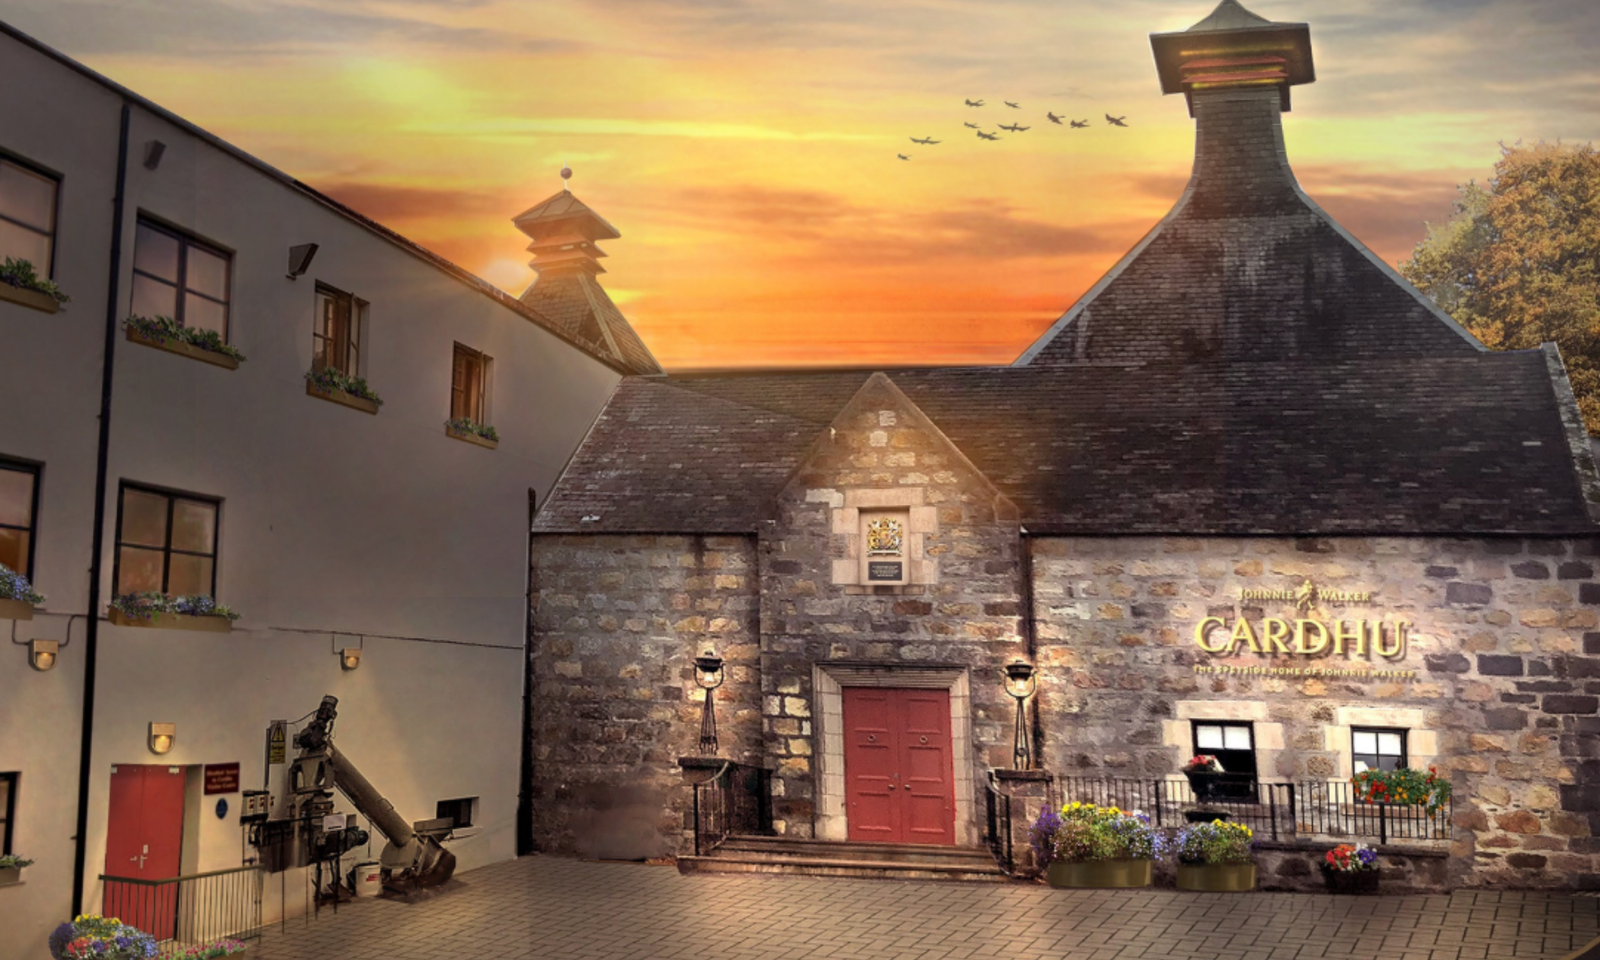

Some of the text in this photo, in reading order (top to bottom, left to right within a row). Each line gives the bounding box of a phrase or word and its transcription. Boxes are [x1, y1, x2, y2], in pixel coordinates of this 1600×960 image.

[1237, 589, 1370, 601] JOHNNIE WALKER
[1194, 616, 1407, 657] CARDHU
[1193, 665, 1213, 674] THE
[1217, 666, 1266, 675] SPEYSIDE
[1271, 667, 1301, 675] HOME
[1321, 668, 1367, 676] JOHNNIE
[1371, 669, 1415, 677] WALKER
